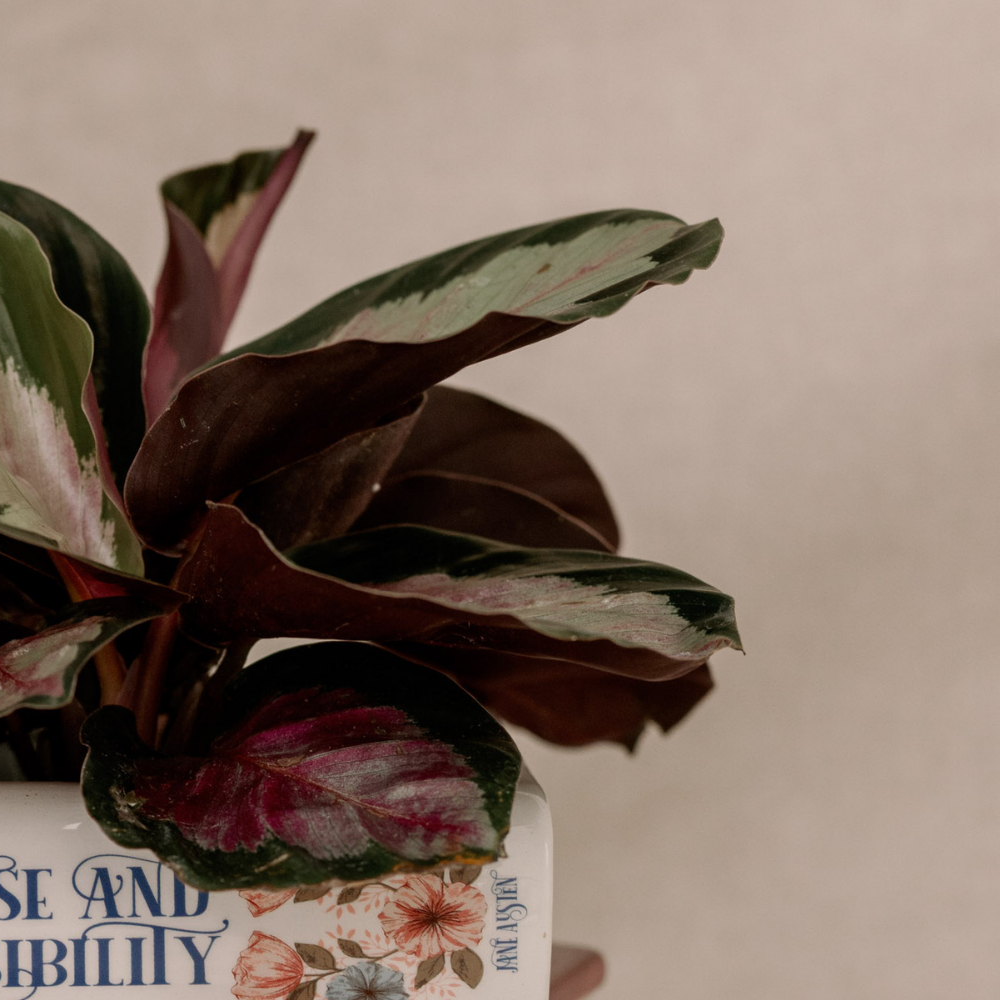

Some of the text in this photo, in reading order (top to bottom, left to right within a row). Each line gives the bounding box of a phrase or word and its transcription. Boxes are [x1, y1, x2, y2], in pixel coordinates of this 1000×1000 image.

[72, 854, 209, 919] AND
[490, 869, 527, 973] JANE AUSTEN
